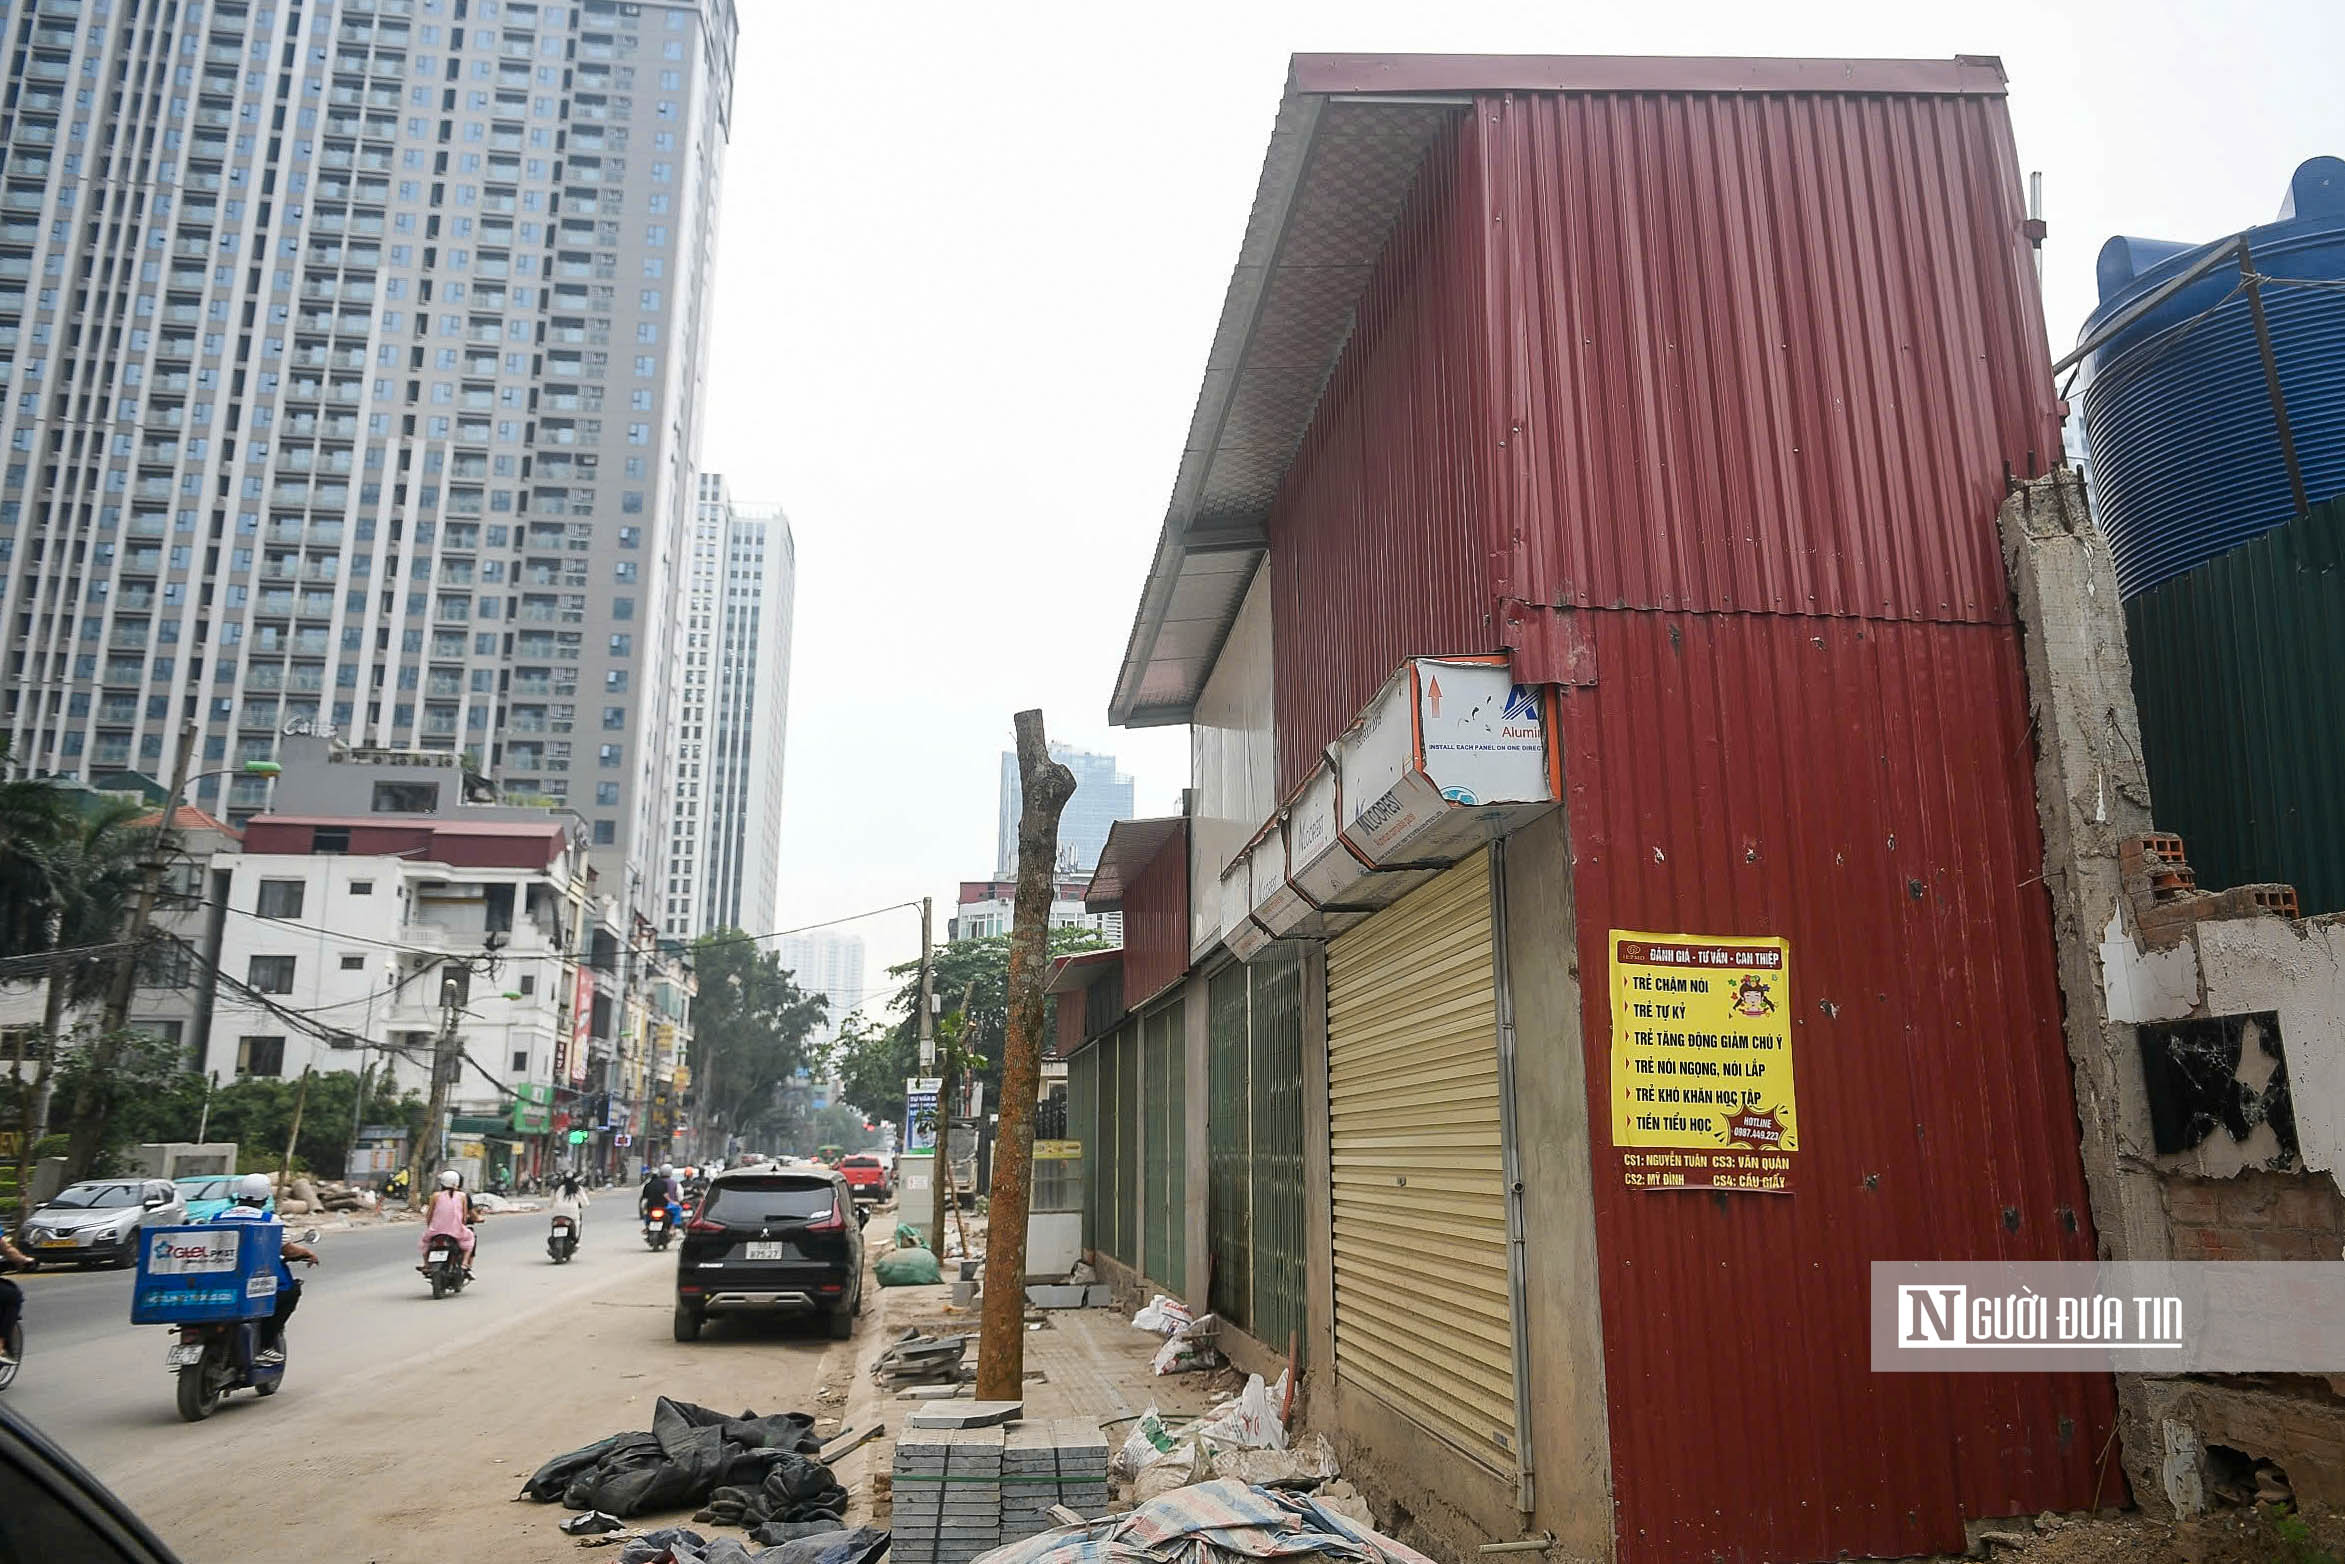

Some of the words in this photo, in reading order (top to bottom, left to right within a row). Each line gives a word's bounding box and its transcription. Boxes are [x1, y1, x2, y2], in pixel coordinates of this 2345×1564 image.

[1676, 948, 1690, 963] GIÁ
[1698, 950, 1709, 963] TƯ
[1735, 952, 1753, 965] CAN
[1755, 950, 1779, 968] THIỆP
[1633, 973, 1652, 990] TRẺ
[1655, 976, 1687, 994] CHẬM
[1690, 977, 1709, 993] NÓI
[1634, 1000, 1653, 1018] TRẺ
[1656, 1004, 1670, 1021] TỰ
[1672, 1002, 1686, 1019] KỶ
[1634, 1028, 1653, 1046] TRẺ
[1657, 1030, 1685, 1047] TĂNG
[1688, 1031, 1717, 1050] ĐỘNG
[1720, 1031, 1749, 1048] GIẢM
[1752, 1033, 1773, 1049] CHÚ
[1776, 1034, 1783, 1050] Ý
[1635, 1056, 1654, 1074] TRẺ
[1657, 1058, 1676, 1075] NÓI
[1680, 1061, 1720, 1078] NGỌNG,
[1723, 1061, 1742, 1077] NÓI
[1745, 1058, 1766, 1077] LẮP
[1636, 1084, 1655, 1102] TRẺ
[1658, 1087, 1680, 1103] KHÓ
[1683, 1087, 1713, 1104] KHĂN
[1716, 1091, 1738, 1107] HỌC
[1741, 1088, 1761, 1107] TẬP
[1663, 1112, 1686, 1131] TIỂU
[1690, 1118, 1712, 1134] HỌC
[1744, 1116, 1772, 1128] HOTLINE
[1624, 1154, 1644, 1166] CS1:
[1646, 1151, 1682, 1167] NGUYỄN
[1712, 1156, 1735, 1168] CS3:
[1737, 1154, 1759, 1169] VĂN
[1625, 1173, 1645, 1185] CS2:
[1647, 1171, 1661, 1185] MỸ
[1663, 1171, 1684, 1186] ĐÌNH
[1713, 1175, 1737, 1187] CS4:
